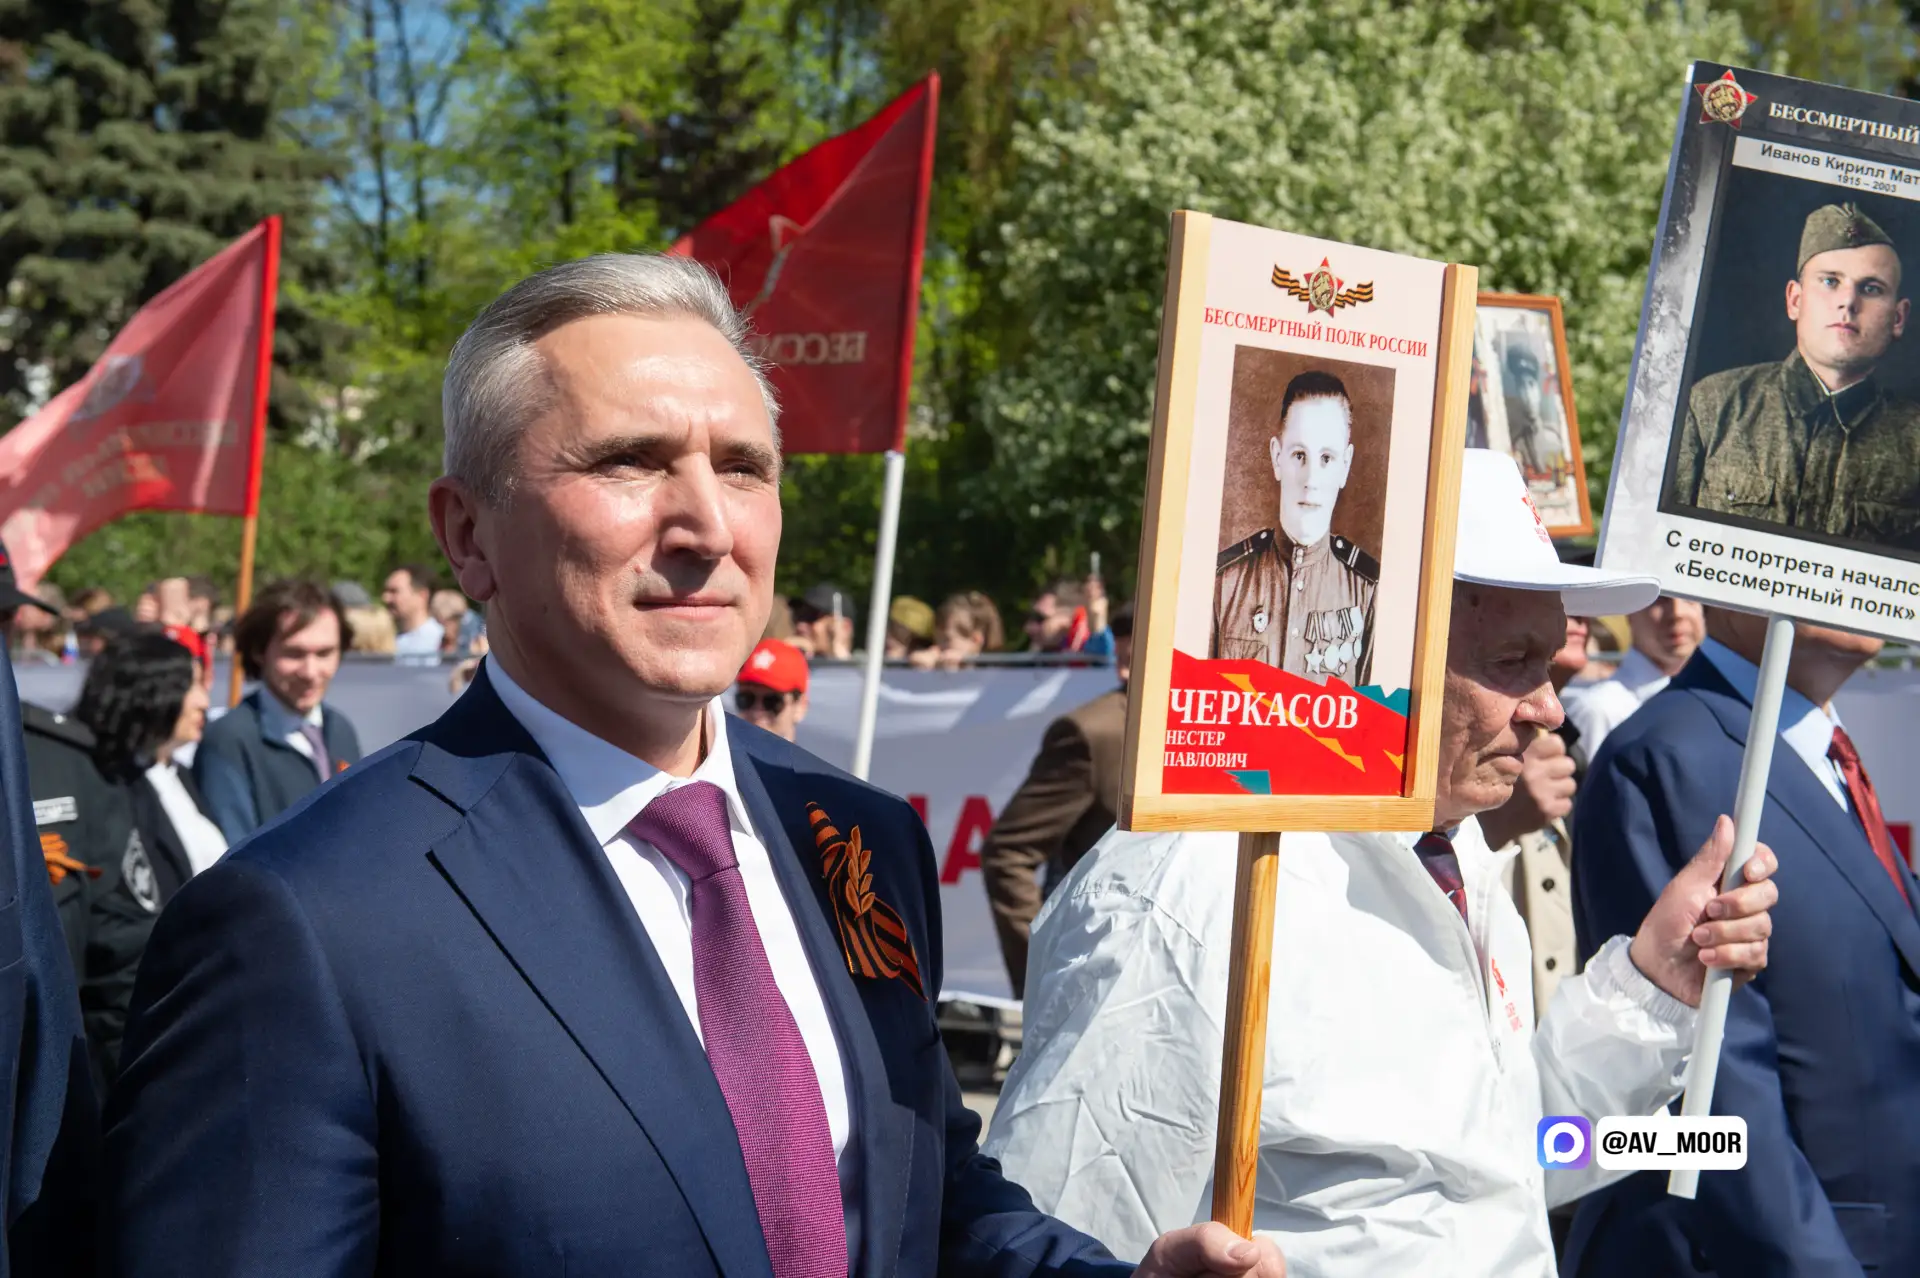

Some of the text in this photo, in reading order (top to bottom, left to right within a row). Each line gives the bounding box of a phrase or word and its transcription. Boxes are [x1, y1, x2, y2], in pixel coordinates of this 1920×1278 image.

[1769, 101, 1919, 145] БЕССМЕРТНЫЙ
[1760, 143, 1820, 166] Иванов
[1826, 155, 1885, 178] Кирилл
[1837, 174, 1861, 187] 1915
[1873, 180, 1897, 193] 2003
[1204, 307, 1428, 357] БЕССМЕРТНЫЙ ПОЛК РОССИИ
[1666, 530, 1920, 596] С его портрета началс
[1675, 560, 1916, 620] «Бессмертный полк»
[1170, 688, 1359, 729] ЧЕРКАСОВ
[1165, 729, 1226, 746] НЕСТЕР
[1163, 751, 1248, 768] ПАВЛОВИЧ
